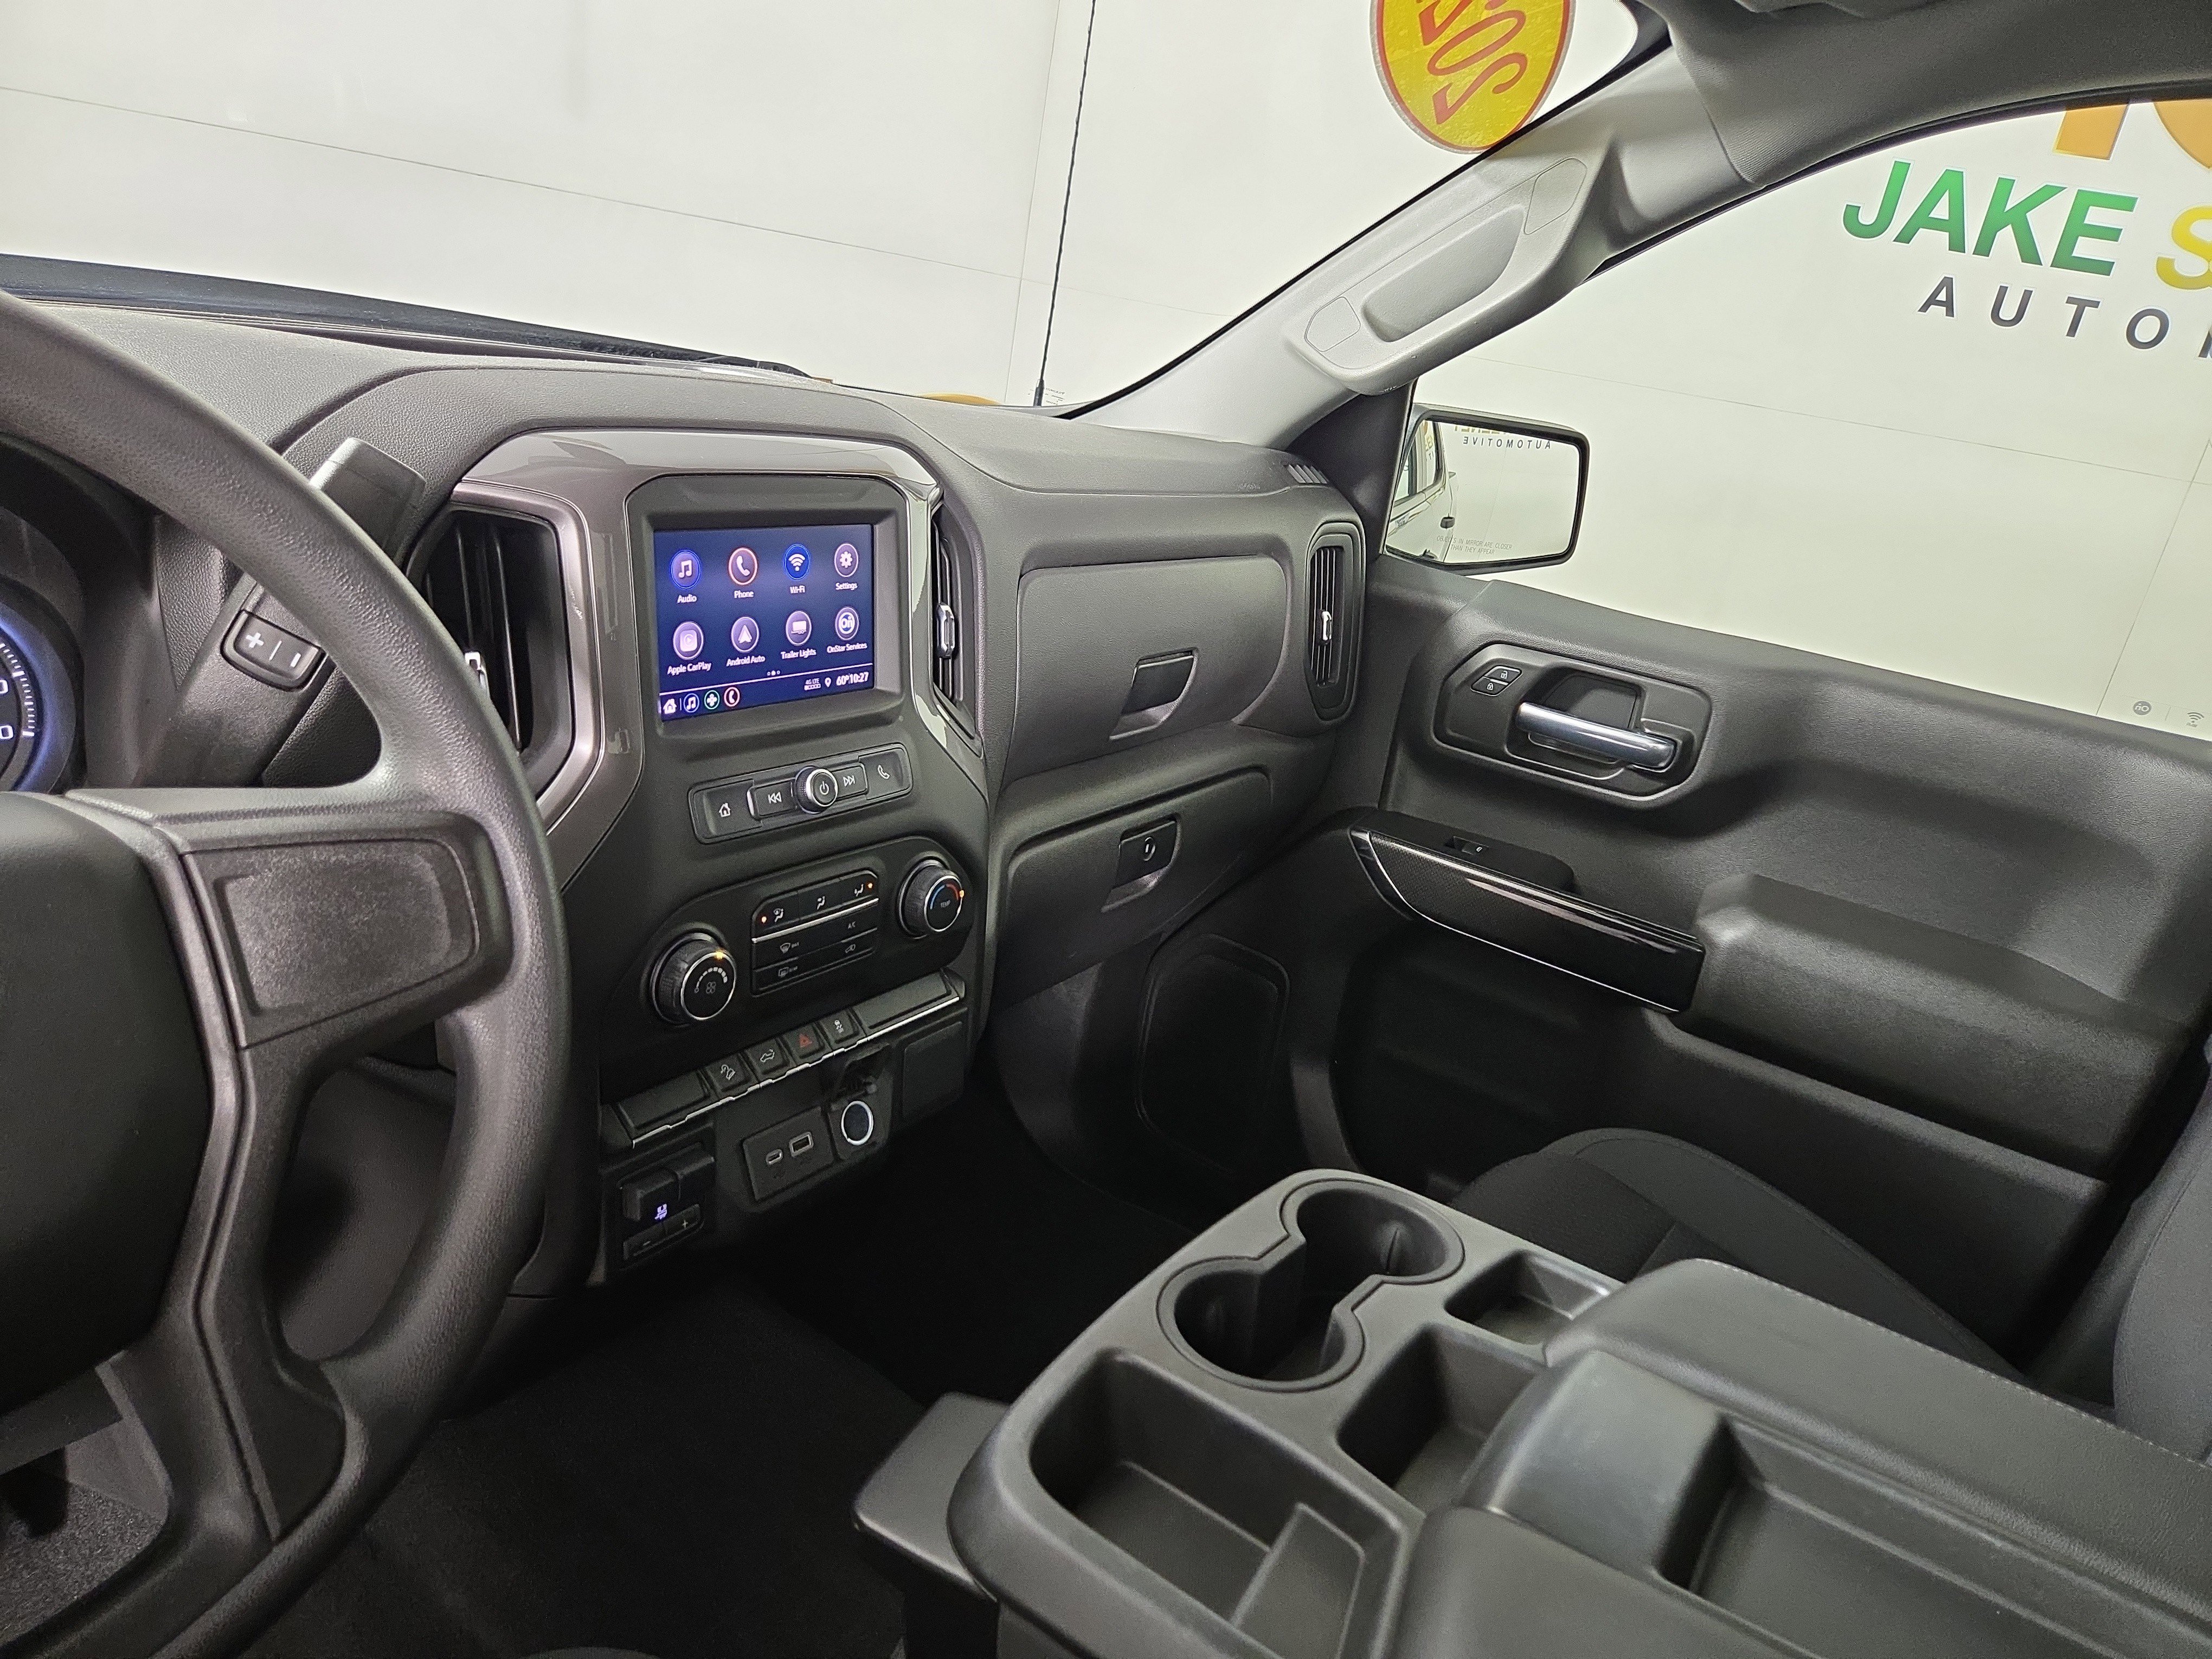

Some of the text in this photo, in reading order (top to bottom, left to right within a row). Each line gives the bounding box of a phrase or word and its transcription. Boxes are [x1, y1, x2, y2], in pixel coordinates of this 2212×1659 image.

[1843, 160, 2139, 276] JAKE
[789, 585, 806, 594] Wi-Fi
[835, 582, 858, 590] Settings
[677, 594, 697, 603] Audio
[734, 590, 754, 599] Phone
[827, 642, 868, 653] OnStar Services
[780, 648, 817, 659] Trailer Lights
[726, 655, 766, 667] Android Auto
[667, 661, 712, 676] Apple CarPlay
[850, 671, 869, 684] 10:27
